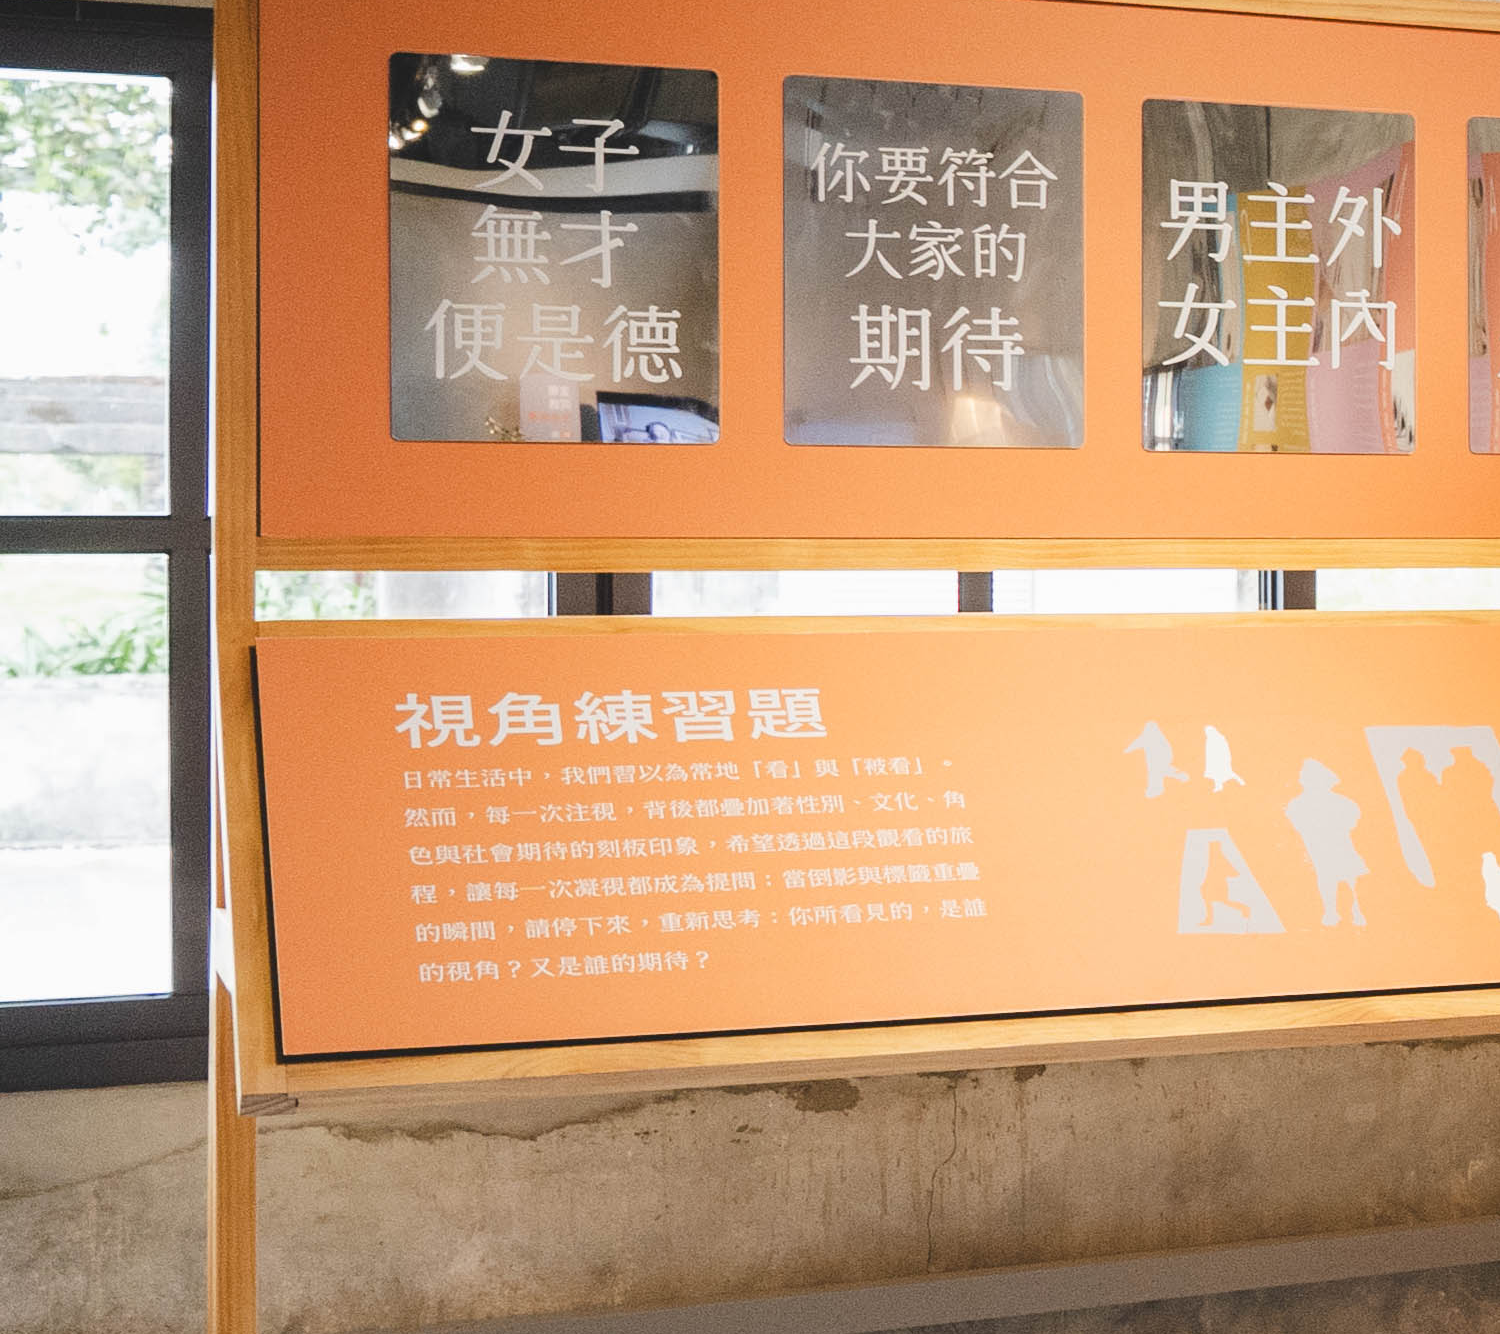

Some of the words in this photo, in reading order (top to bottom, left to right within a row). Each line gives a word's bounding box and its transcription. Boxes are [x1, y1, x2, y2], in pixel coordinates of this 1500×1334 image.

[471, 110, 639, 193] 女子
[811, 142, 1058, 209] 你要符合
[471, 205, 639, 288] 無才
[845, 220, 1026, 283] 大家的
[1160, 179, 1402, 268] 男主外
[424, 298, 682, 383] 便是德
[850, 304, 1024, 392] 期待
[1158, 282, 1397, 370] 女主內
[396, 688, 827, 748] 視角練習題
